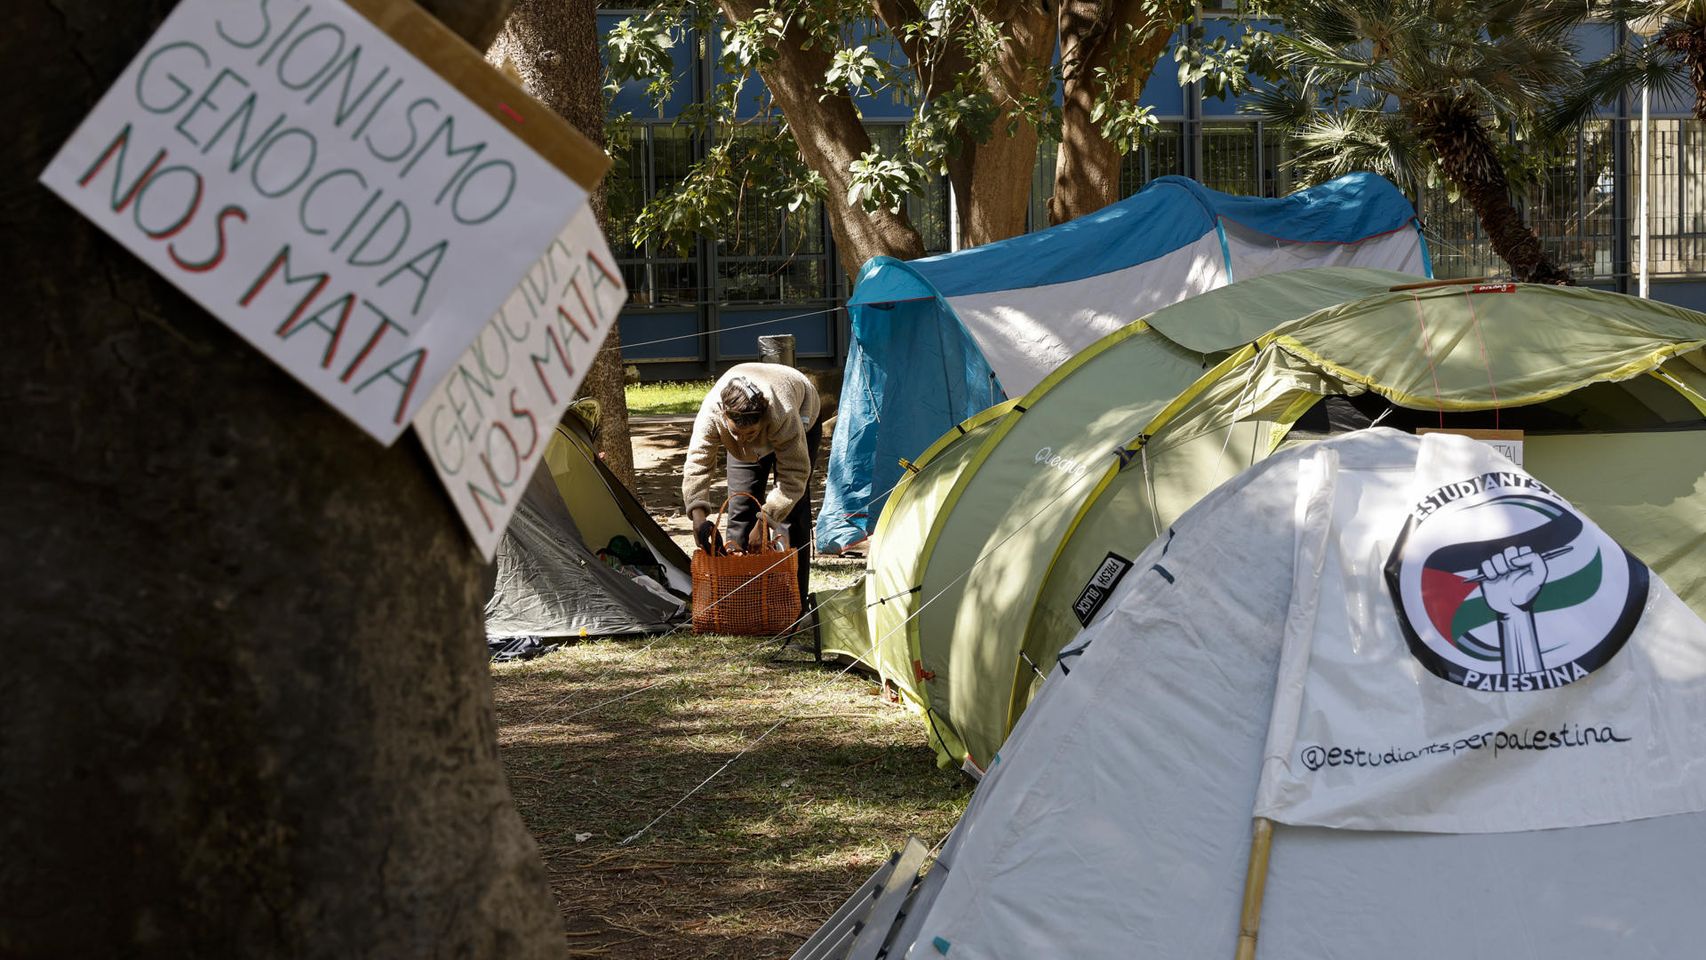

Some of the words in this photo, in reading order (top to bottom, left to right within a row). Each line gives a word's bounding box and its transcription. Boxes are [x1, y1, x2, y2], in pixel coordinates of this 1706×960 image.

[215, 0, 517, 226] SIONISMO
[135, 41, 450, 316] GENOCIDA
[78, 122, 249, 273] NOS
[239, 244, 430, 426] MATA
[467, 387, 539, 532] NOS
[530, 250, 622, 405] MATA
[1493, 445, 1521, 466] TAL
[1416, 472, 1542, 519] ESTUDIANTS
[1097, 560, 1120, 586] FRESH
[1076, 588, 1100, 615] BLACK
[1462, 660, 1590, 692] PALESTINA
[1300, 722, 1633, 771] @estudiantsperpalestina
